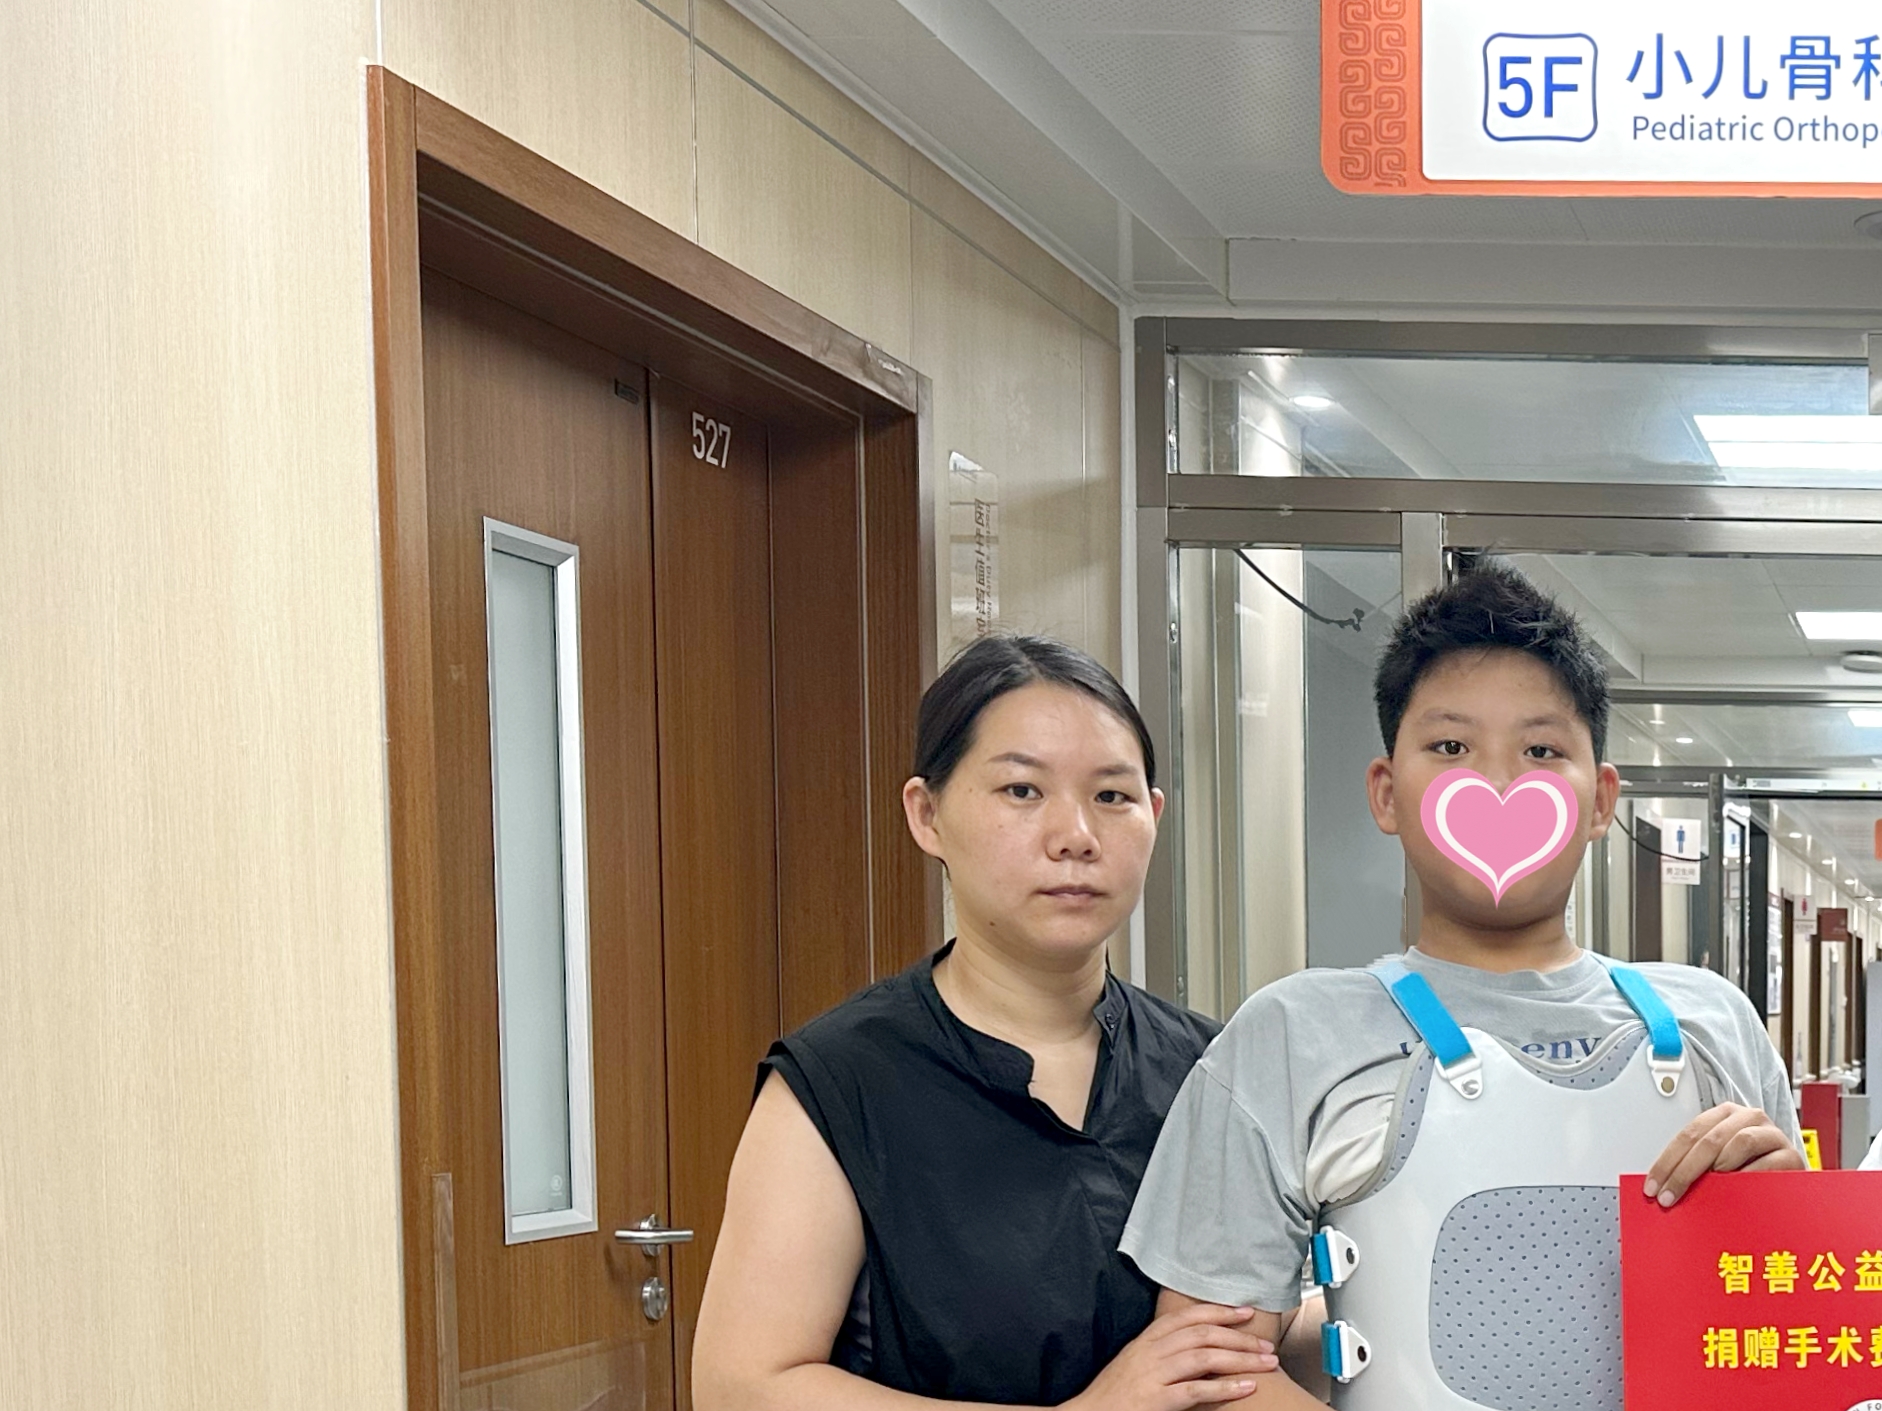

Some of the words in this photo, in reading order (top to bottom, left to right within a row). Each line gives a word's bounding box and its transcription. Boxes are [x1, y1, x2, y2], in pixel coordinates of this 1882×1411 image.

[1497, 54, 1580, 119] 5F
[1633, 113, 1764, 142] Pediatric
[692, 411, 731, 469] 527
